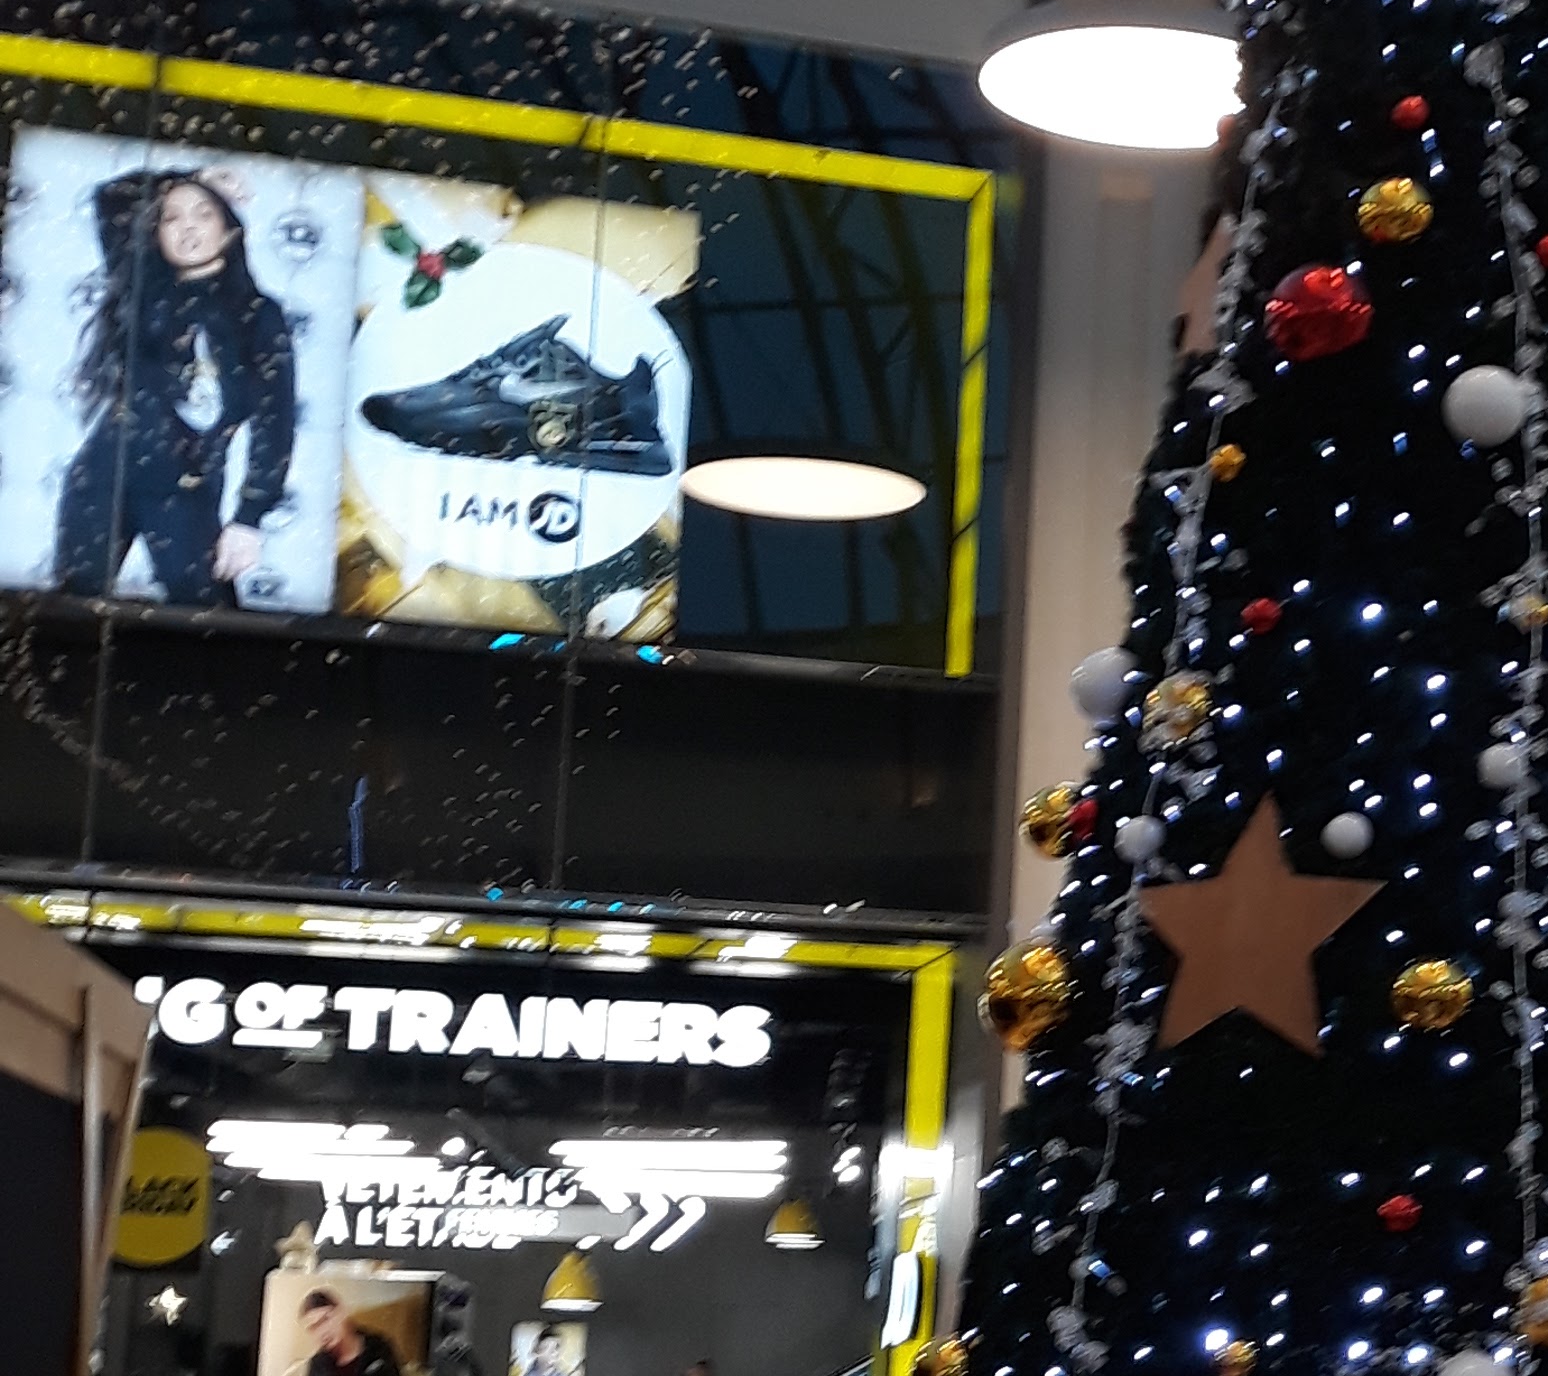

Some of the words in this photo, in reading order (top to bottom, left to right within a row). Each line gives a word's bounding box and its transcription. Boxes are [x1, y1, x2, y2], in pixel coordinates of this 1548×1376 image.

[438, 491, 450, 520] I
[455, 494, 519, 529] AM
[233, 982, 329, 1049] OF
[334, 986, 772, 1067] TRAINERS
